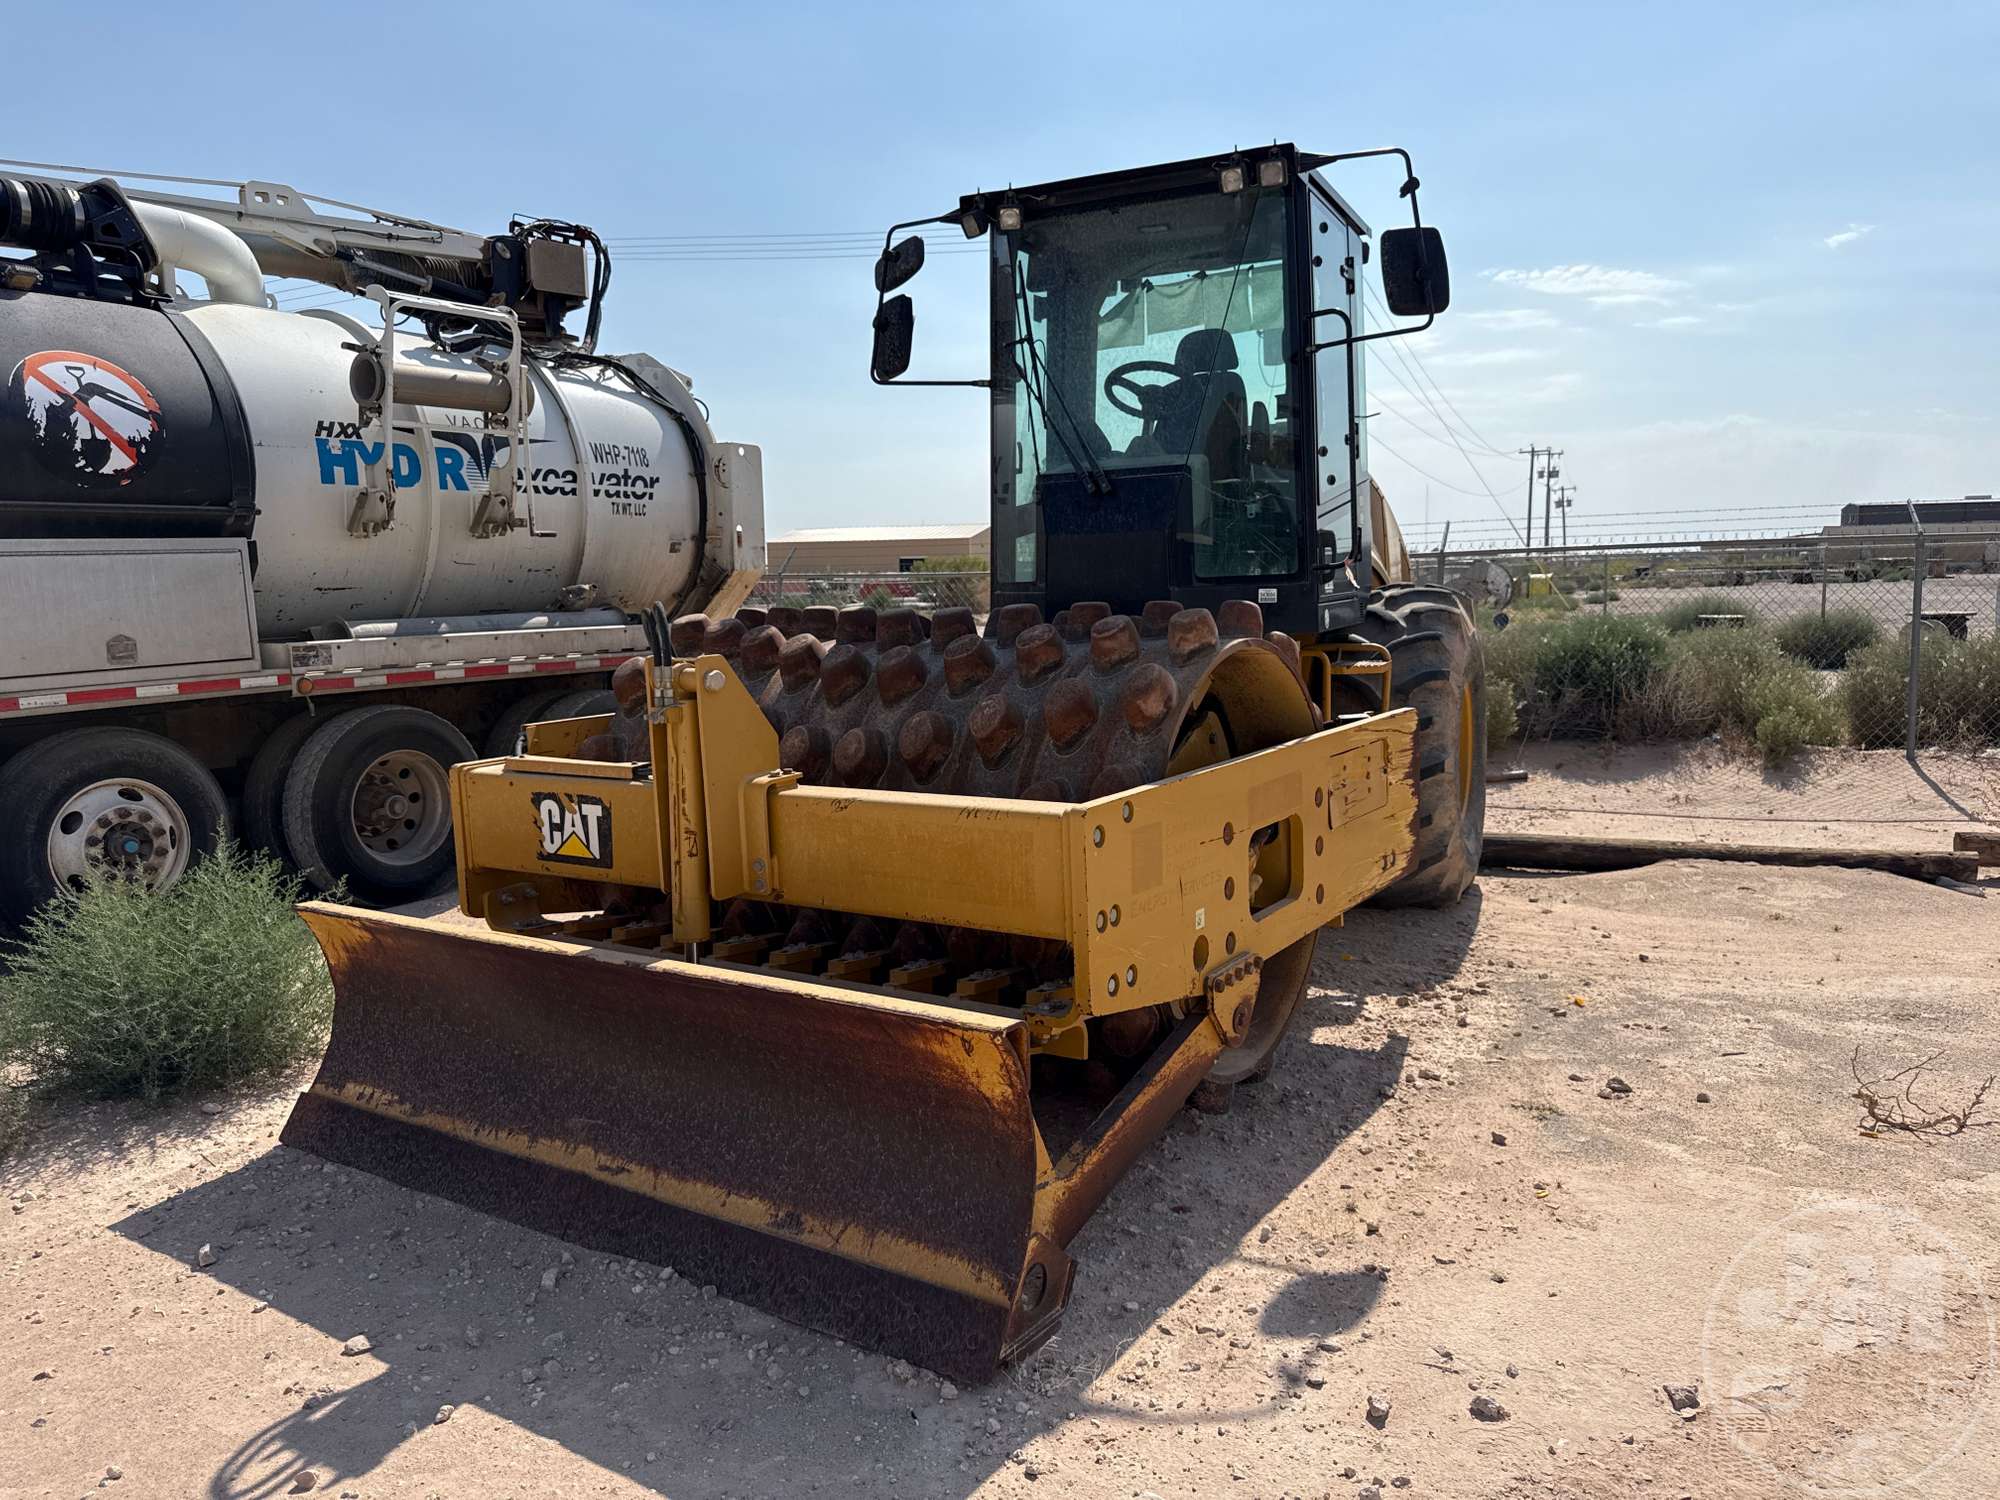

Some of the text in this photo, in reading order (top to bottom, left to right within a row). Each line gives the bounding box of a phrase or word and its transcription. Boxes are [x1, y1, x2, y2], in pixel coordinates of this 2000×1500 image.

[315, 420, 362, 440] HXX
[590, 441, 650, 468] WHP-7118
[611, 502, 621, 516] TX
[634, 504, 647, 517] LLC
[540, 799, 602, 860] CAT
